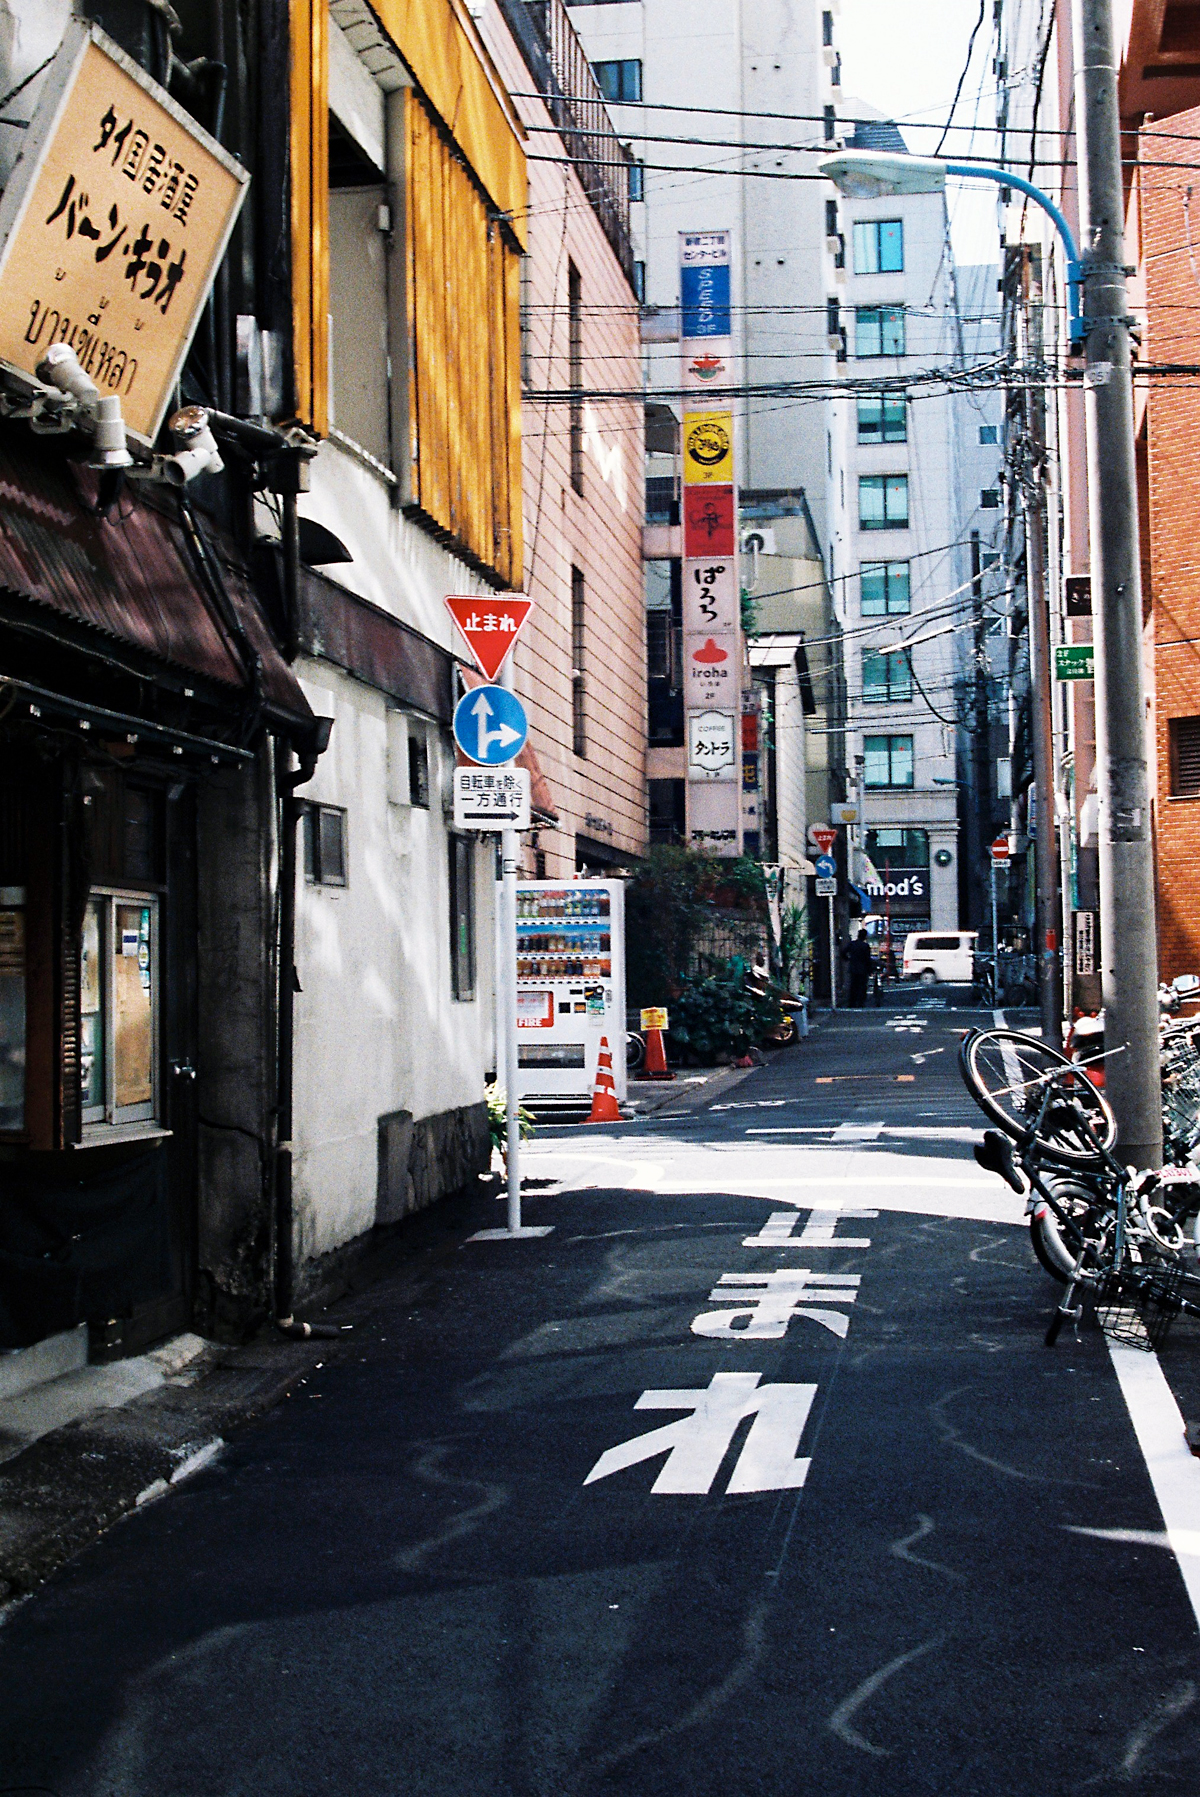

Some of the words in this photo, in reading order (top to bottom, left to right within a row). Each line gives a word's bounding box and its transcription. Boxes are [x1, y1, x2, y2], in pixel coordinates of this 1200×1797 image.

[93, 104, 200, 227] タイ国居酒屋
[698, 268, 714, 322] SPEED
[464, 613, 518, 632] 止まれ
[692, 667, 728, 678] iroha
[695, 740, 730, 756] タントラ
[460, 775, 523, 790] 自転車を除く
[460, 792, 523, 807] 一方通行
[867, 875, 924, 896] mod's
[518, 1018, 543, 1027] FIRE
[583, 1200, 879, 1495] 止まれ
